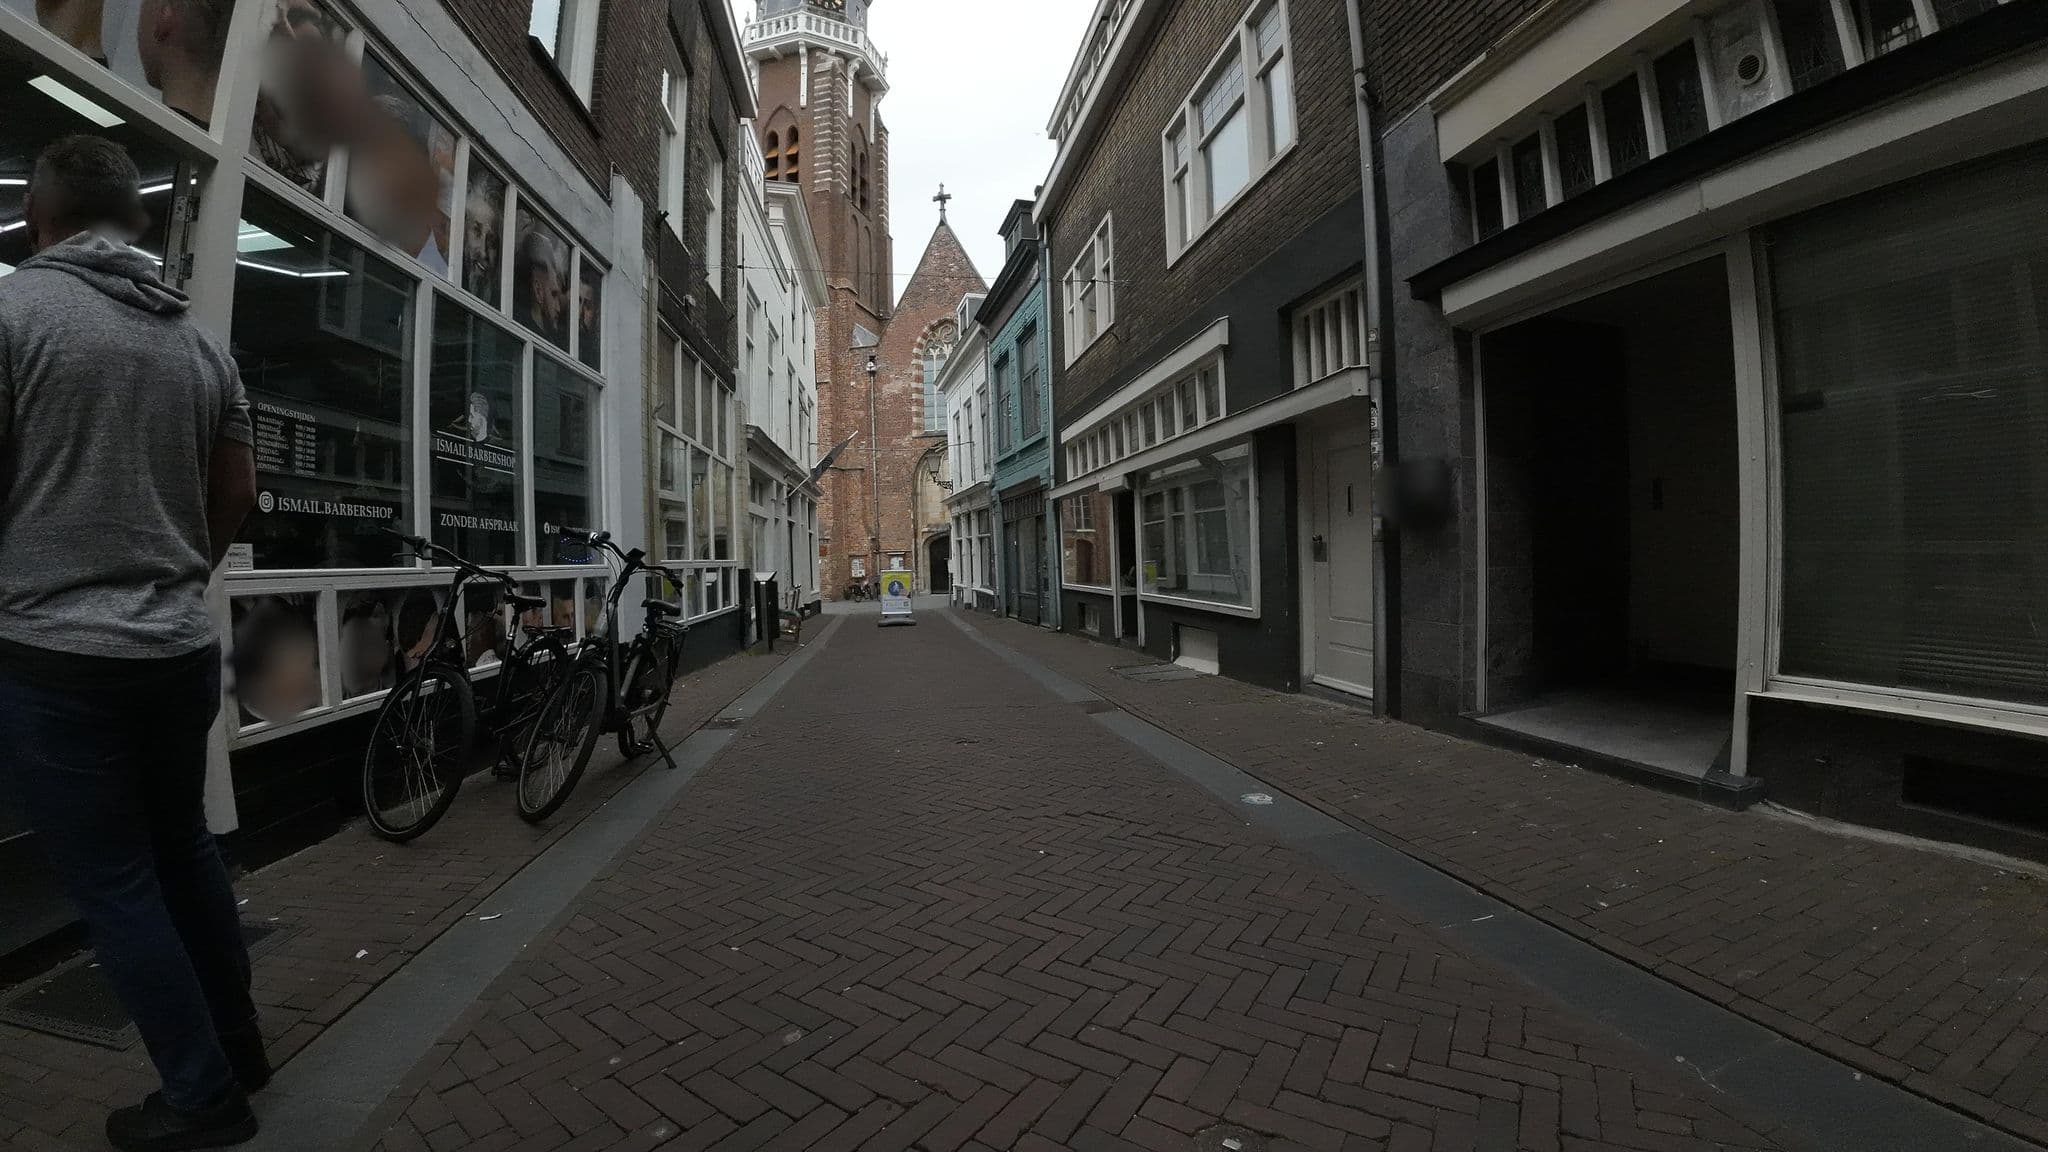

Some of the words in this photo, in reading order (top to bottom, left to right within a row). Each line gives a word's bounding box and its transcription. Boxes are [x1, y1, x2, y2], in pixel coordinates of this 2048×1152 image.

[257, 402, 316, 423] OPENINGSTIJDEN
[436, 438, 467, 457] ISMAIL
[468, 446, 516, 469] BARBERSHOP
[278, 496, 393, 519] ISMAIL.BARBERSHOP
[440, 513, 478, 530] ZONDER
[479, 518, 520, 532] AFSPRAAK
